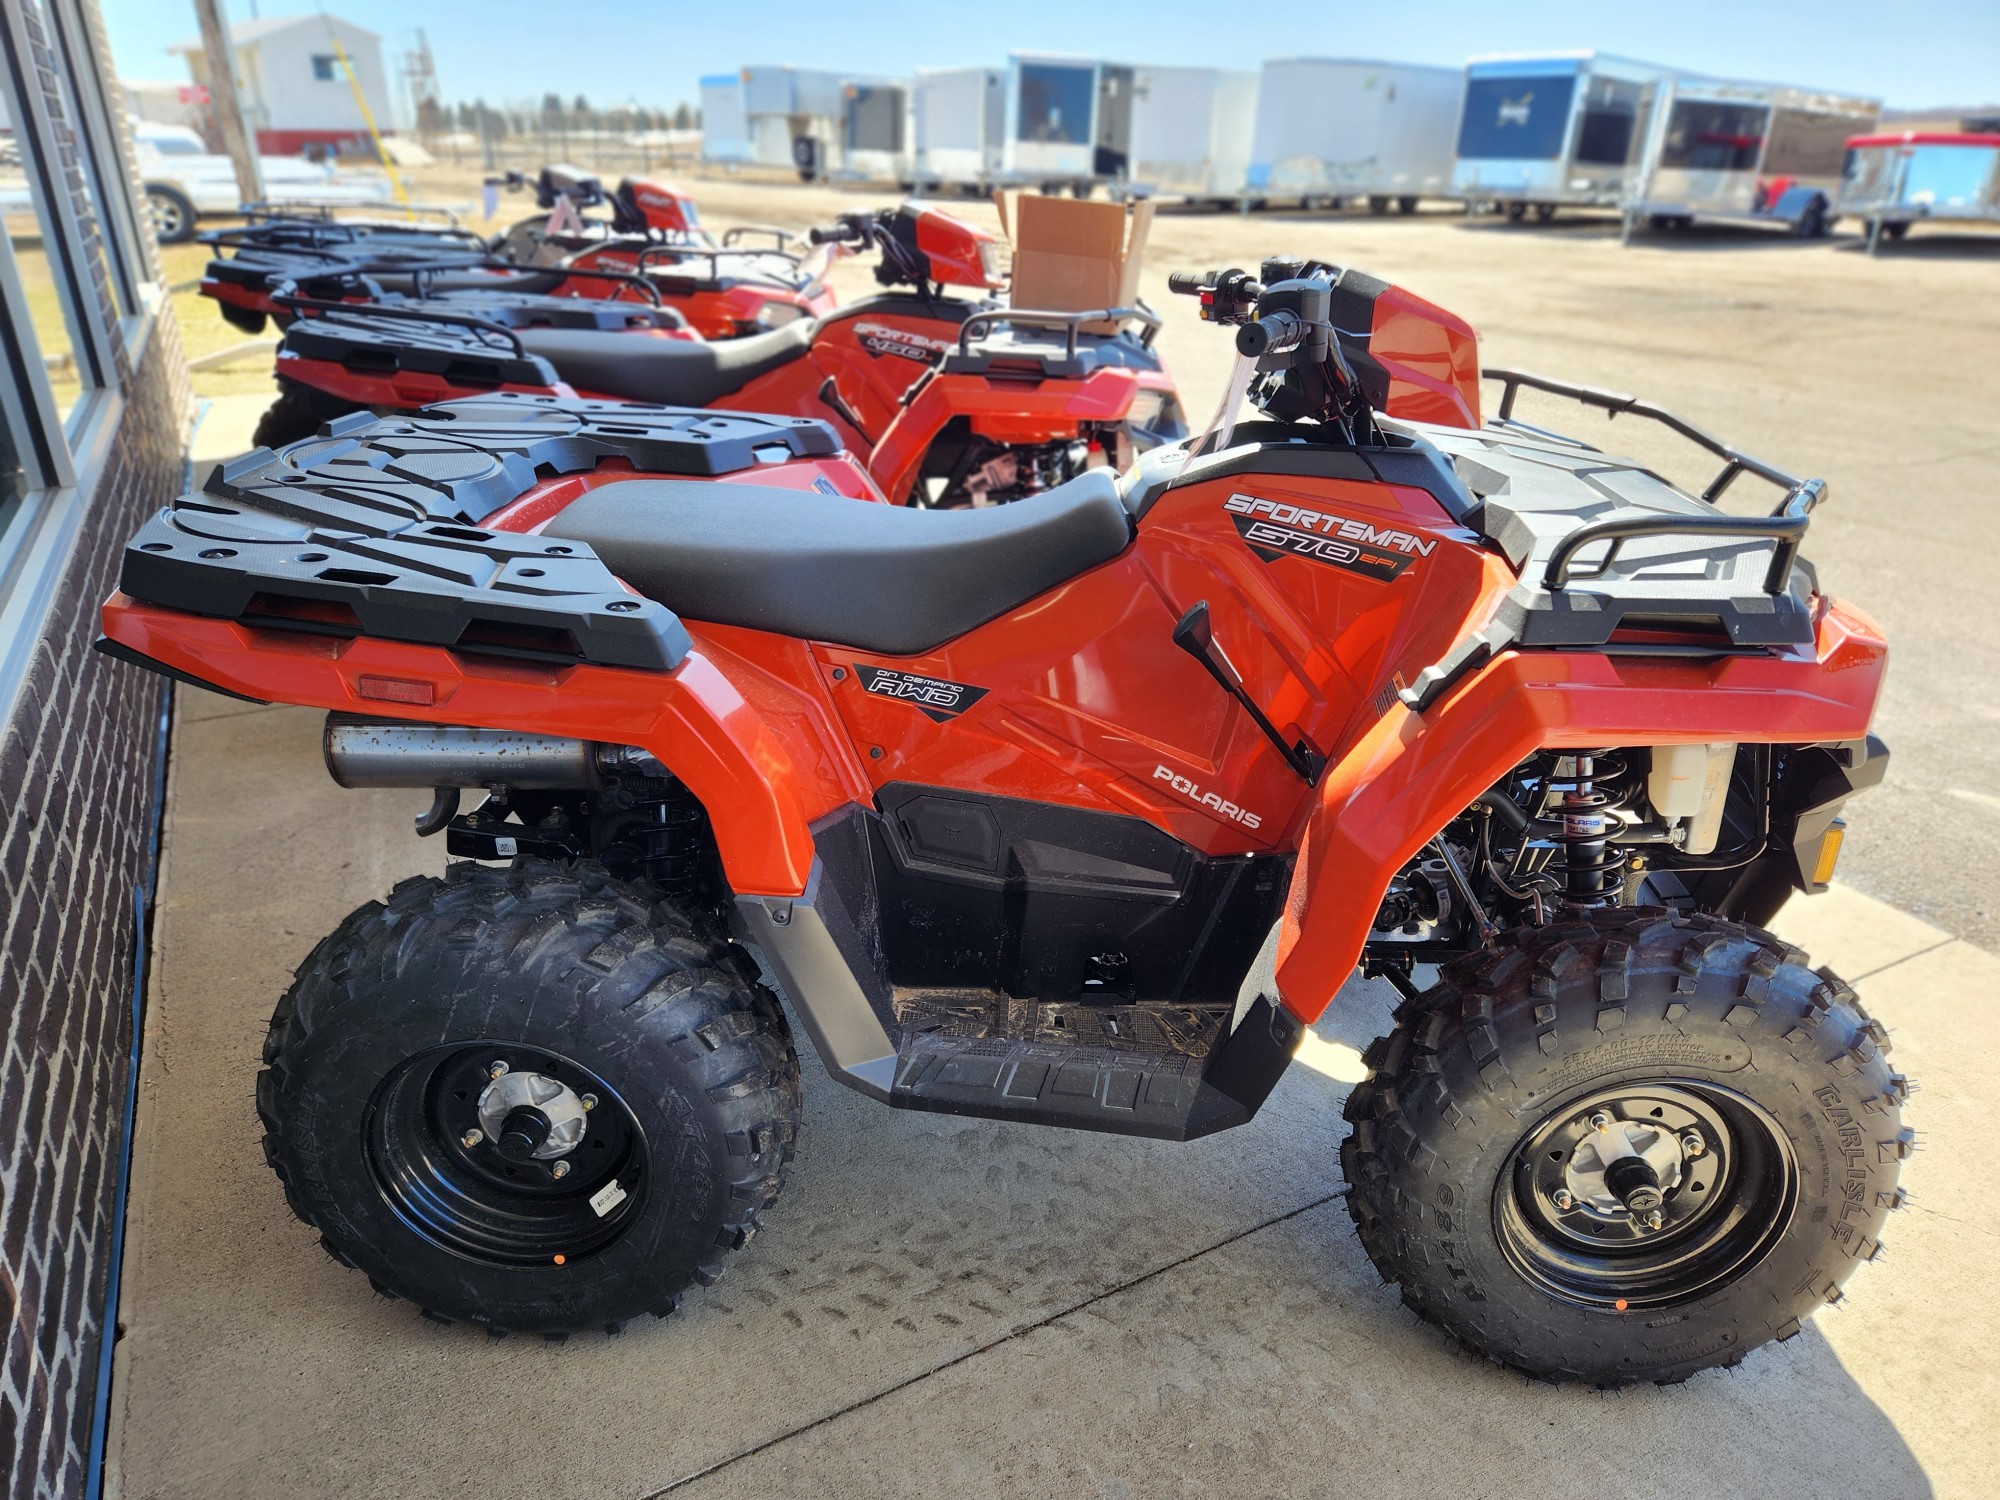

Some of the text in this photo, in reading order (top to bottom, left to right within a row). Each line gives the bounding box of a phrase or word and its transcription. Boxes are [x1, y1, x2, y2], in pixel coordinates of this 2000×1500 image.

[852, 322, 951, 352] SPORTSMA
[866, 337, 927, 360] 450
[1222, 492, 1439, 558] SPORTSMAN
[1244, 521, 1399, 571] 570 EFI
[868, 677, 960, 707] AWD
[903, 674, 965, 693] DEMAND
[1152, 764, 1263, 830] POLARIS
[1812, 1085, 1868, 1245] CARLISLE
